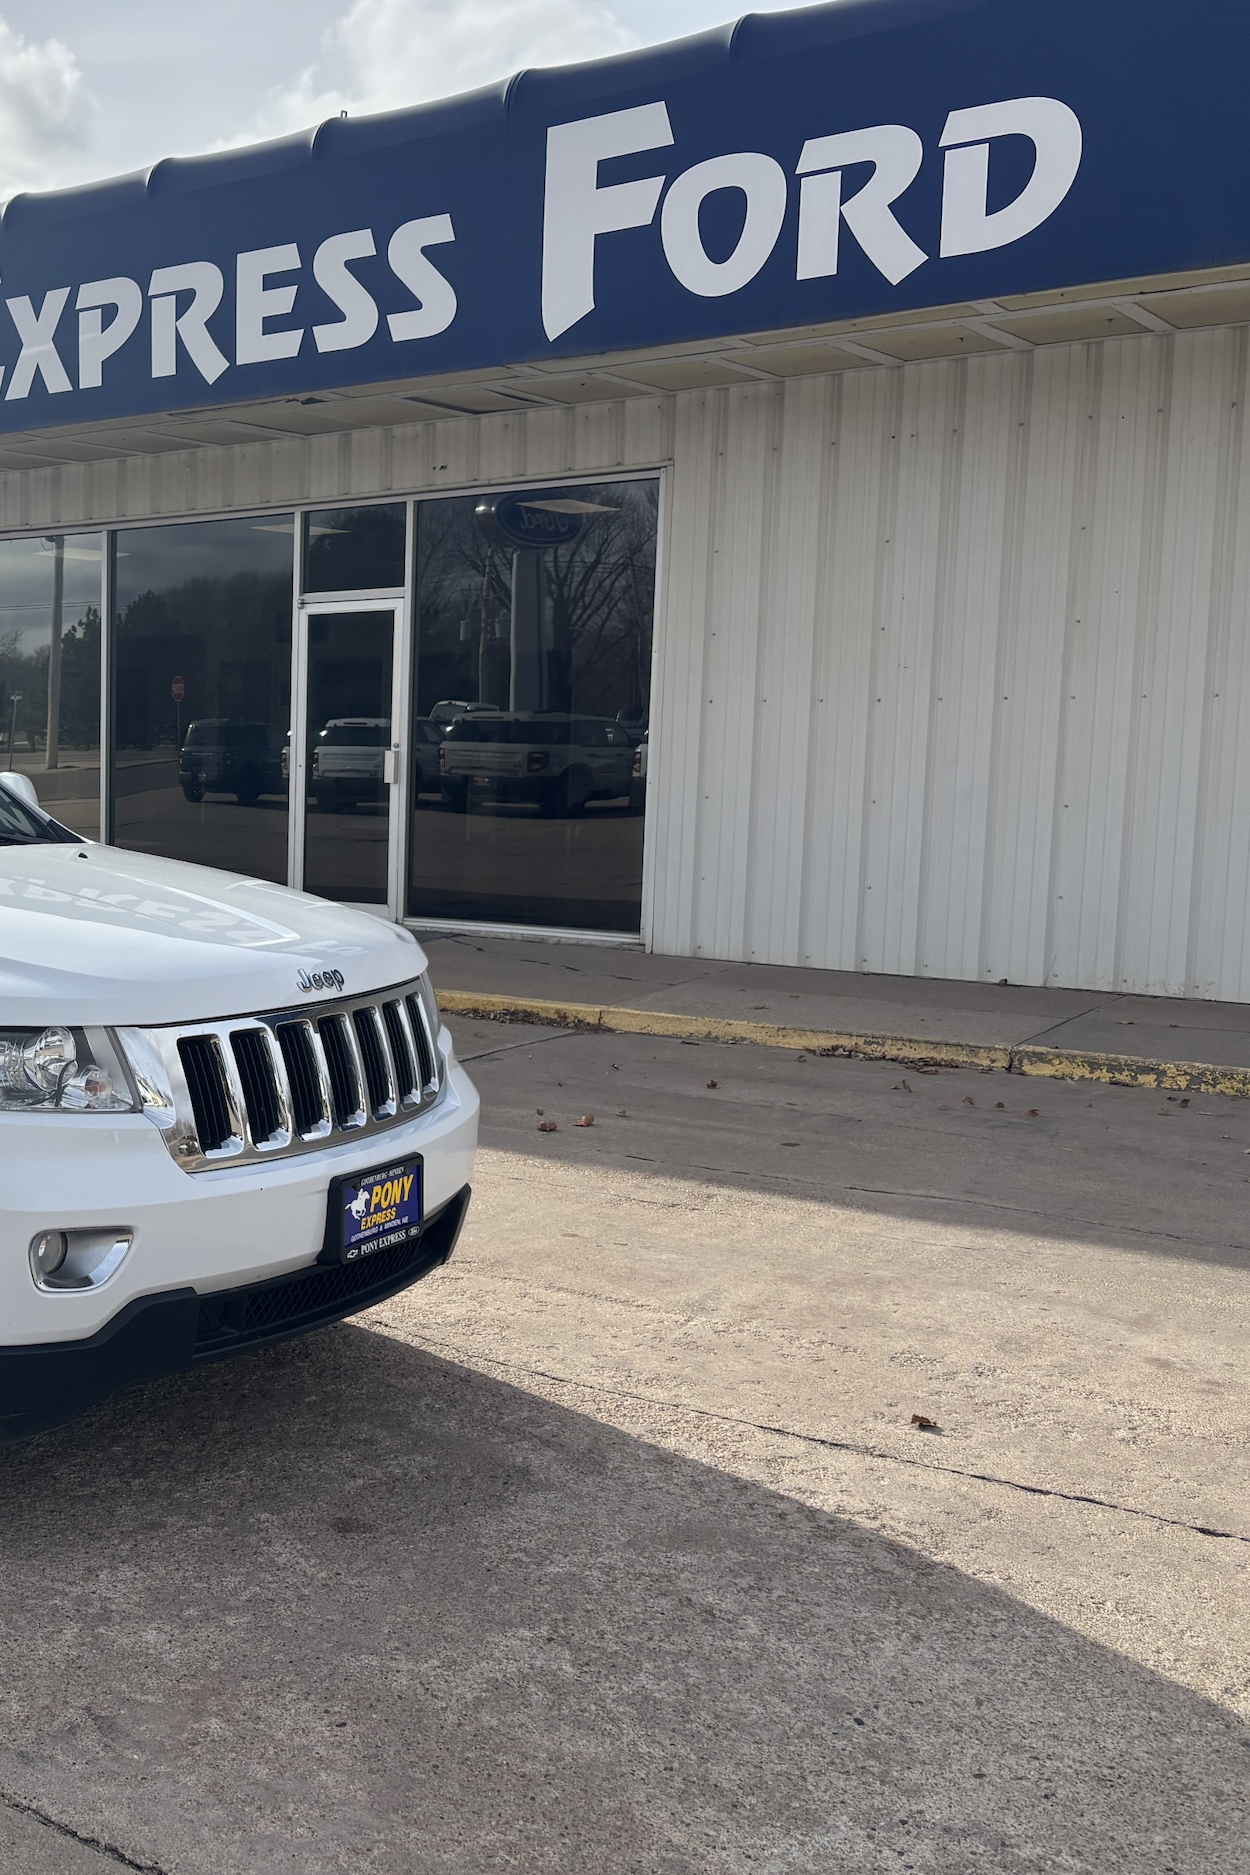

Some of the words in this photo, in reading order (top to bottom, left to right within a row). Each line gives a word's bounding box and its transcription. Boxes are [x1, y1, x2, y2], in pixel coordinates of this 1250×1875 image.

[296, 968, 345, 993] Jeep
[369, 1174, 415, 1213] PONY
[360, 1207, 397, 1231] EXPRESS
[360, 1238, 379, 1255] PONY
[379, 1229, 407, 1249] EXPRESS
